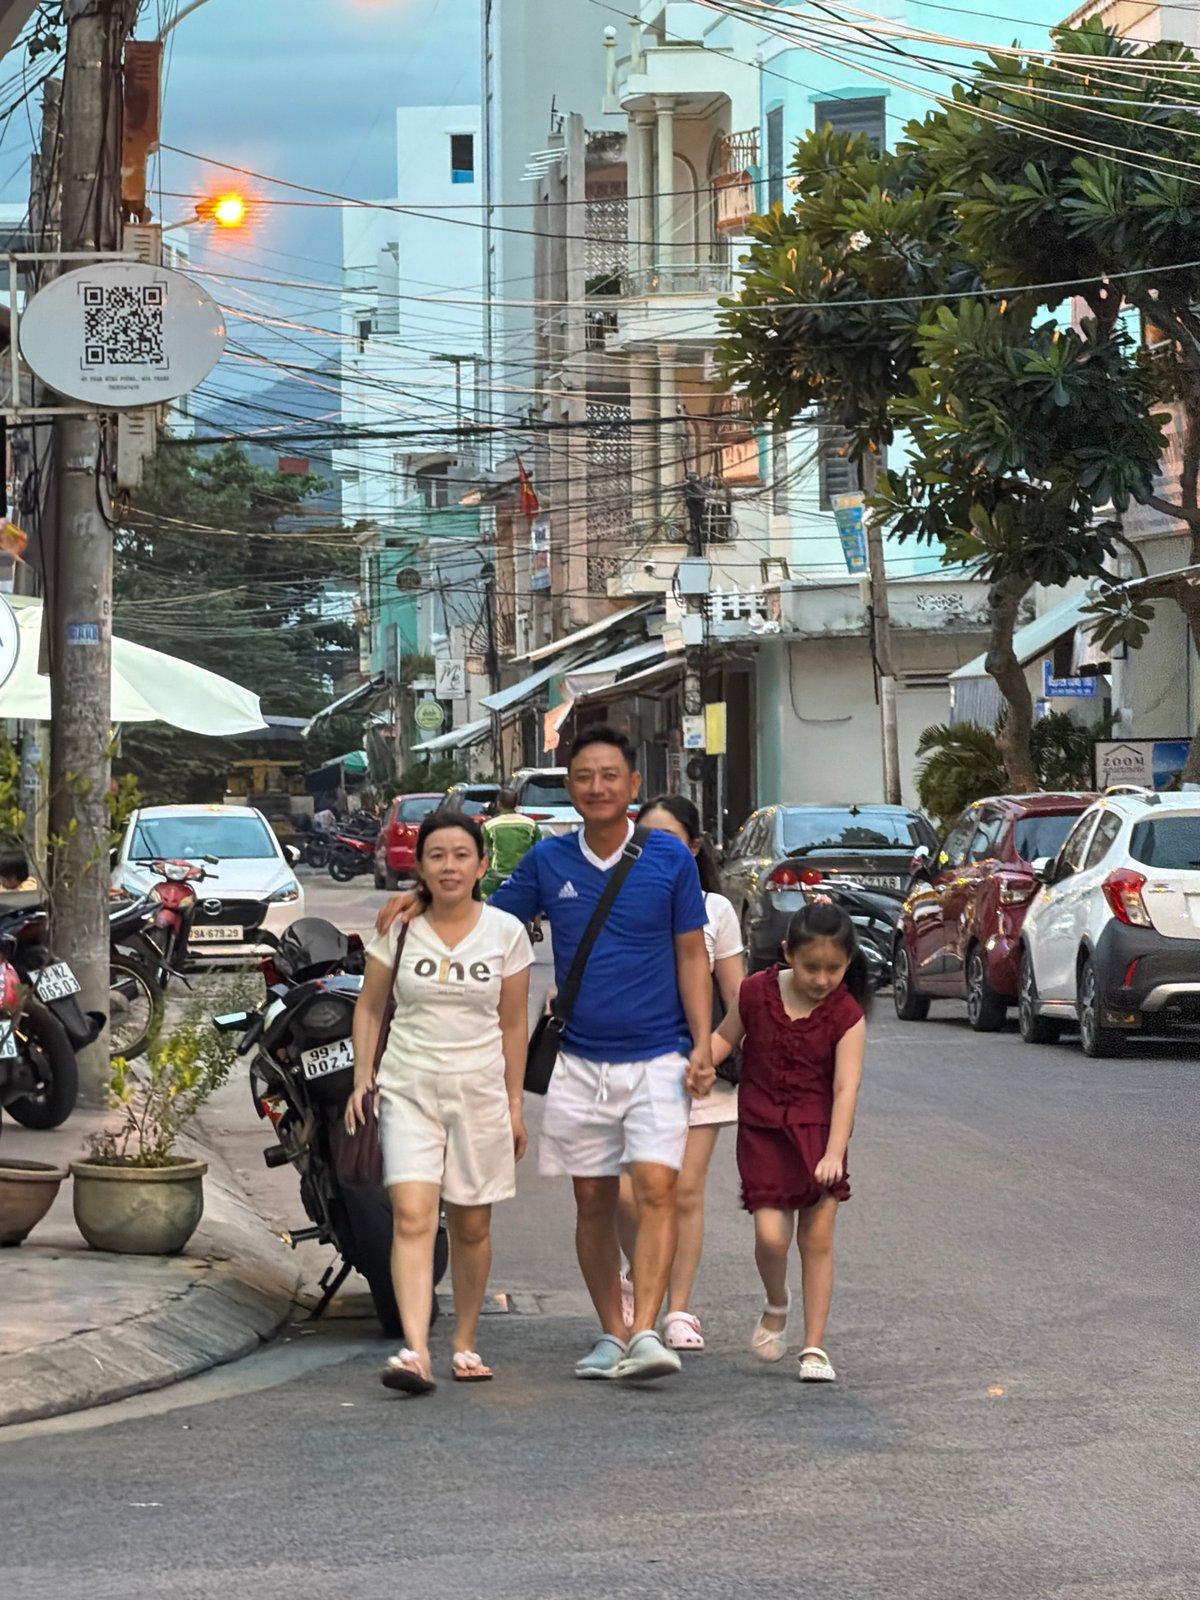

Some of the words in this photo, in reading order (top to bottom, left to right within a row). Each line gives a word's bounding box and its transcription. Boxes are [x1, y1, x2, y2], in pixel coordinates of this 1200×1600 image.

[1104, 756, 1144, 767] ZOOM
[414, 957, 491, 983] one
[310, 1041, 353, 1062] 99-A
